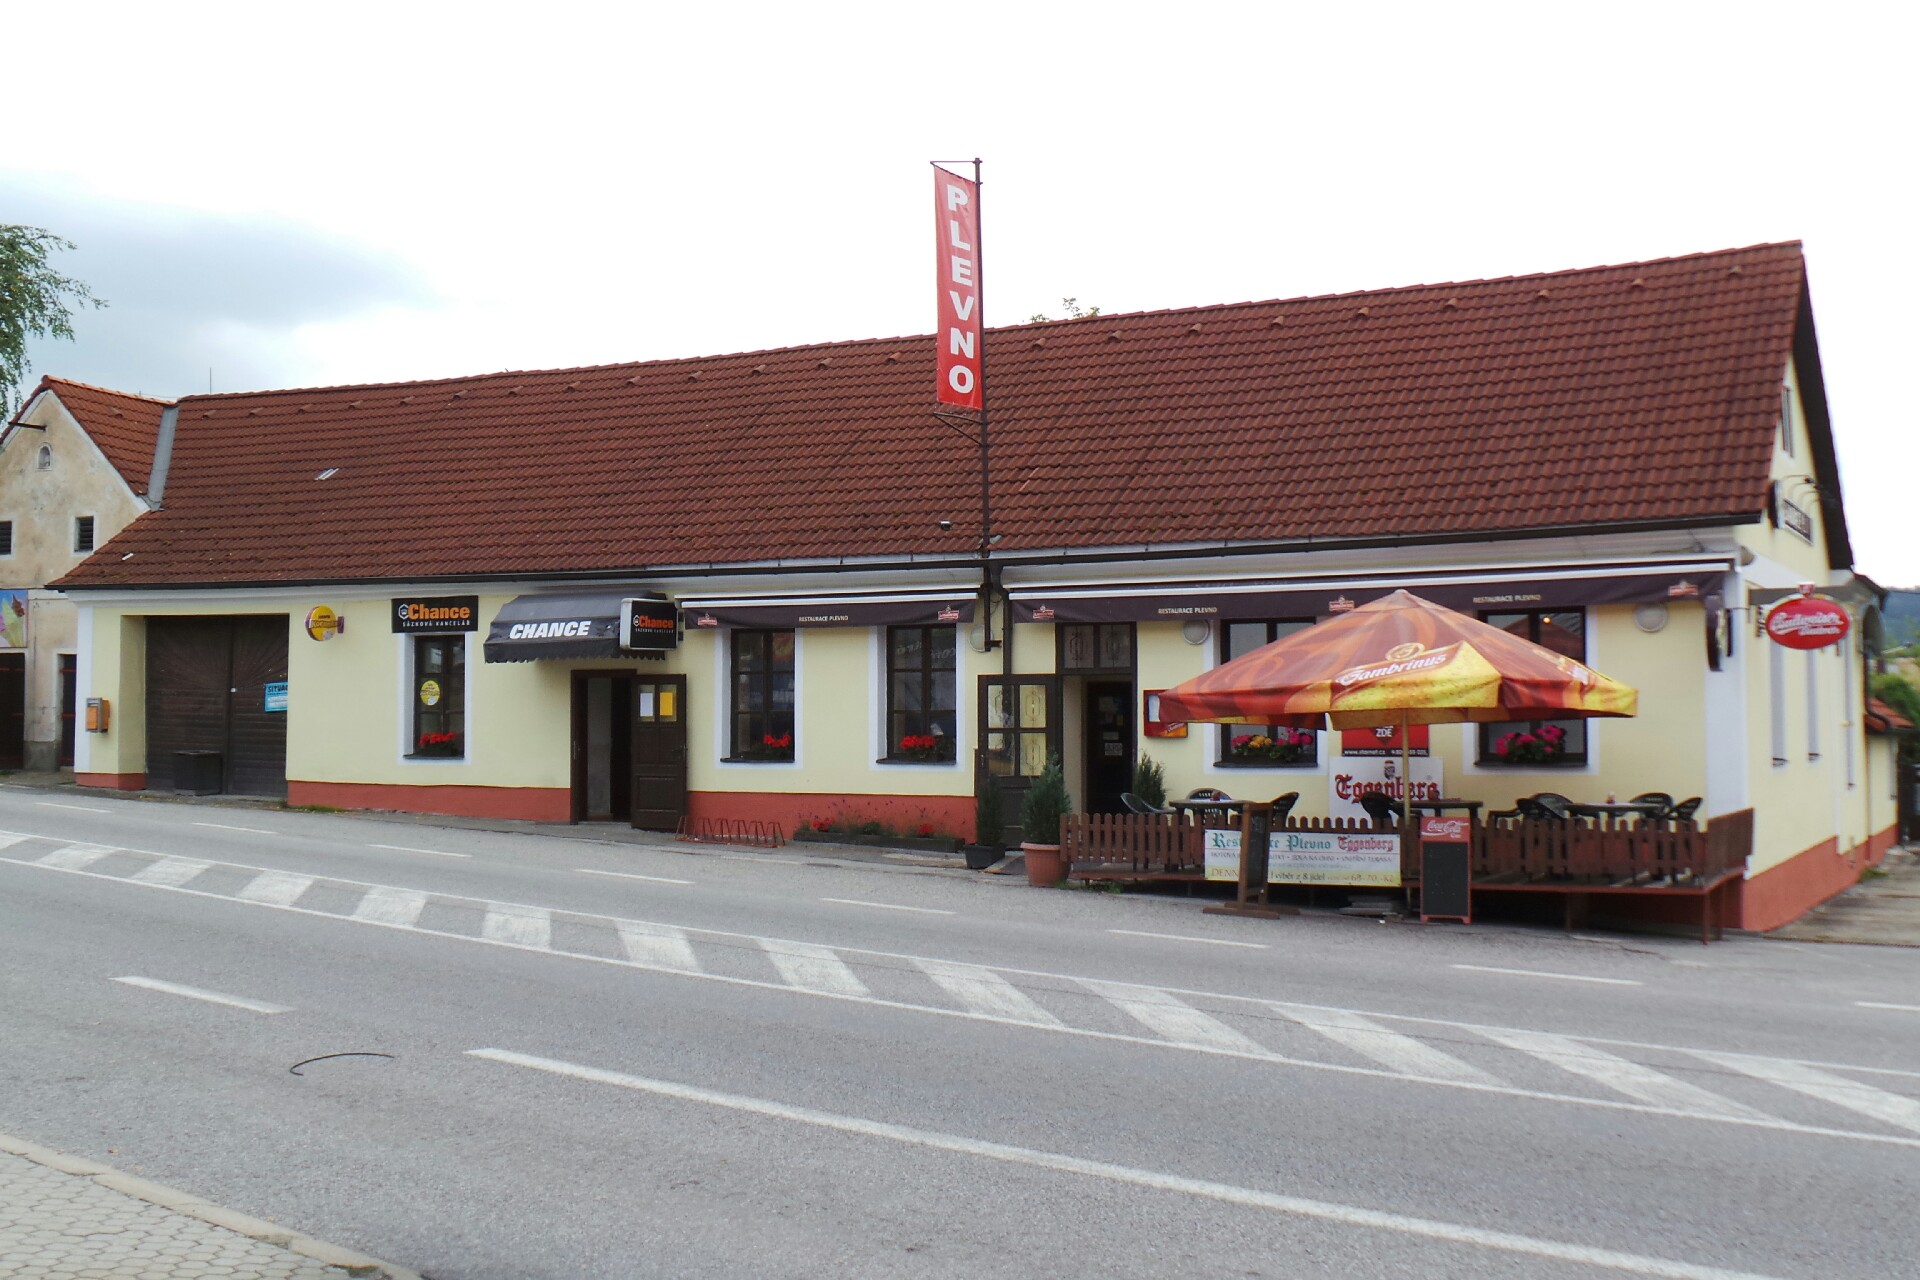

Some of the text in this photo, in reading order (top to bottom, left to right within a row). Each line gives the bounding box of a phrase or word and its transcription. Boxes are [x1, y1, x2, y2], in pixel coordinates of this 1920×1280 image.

[947, 184, 975, 394] PLEVNO
[408, 603, 471, 620] Chance
[509, 620, 592, 640] CHANCE
[639, 615, 673, 628] Chance
[1335, 653, 1447, 686] Gambrinus
[1375, 728, 1393, 737] ZDE
[1287, 834, 1331, 850] Plevno
[1337, 835, 1394, 852] Eggenberg
